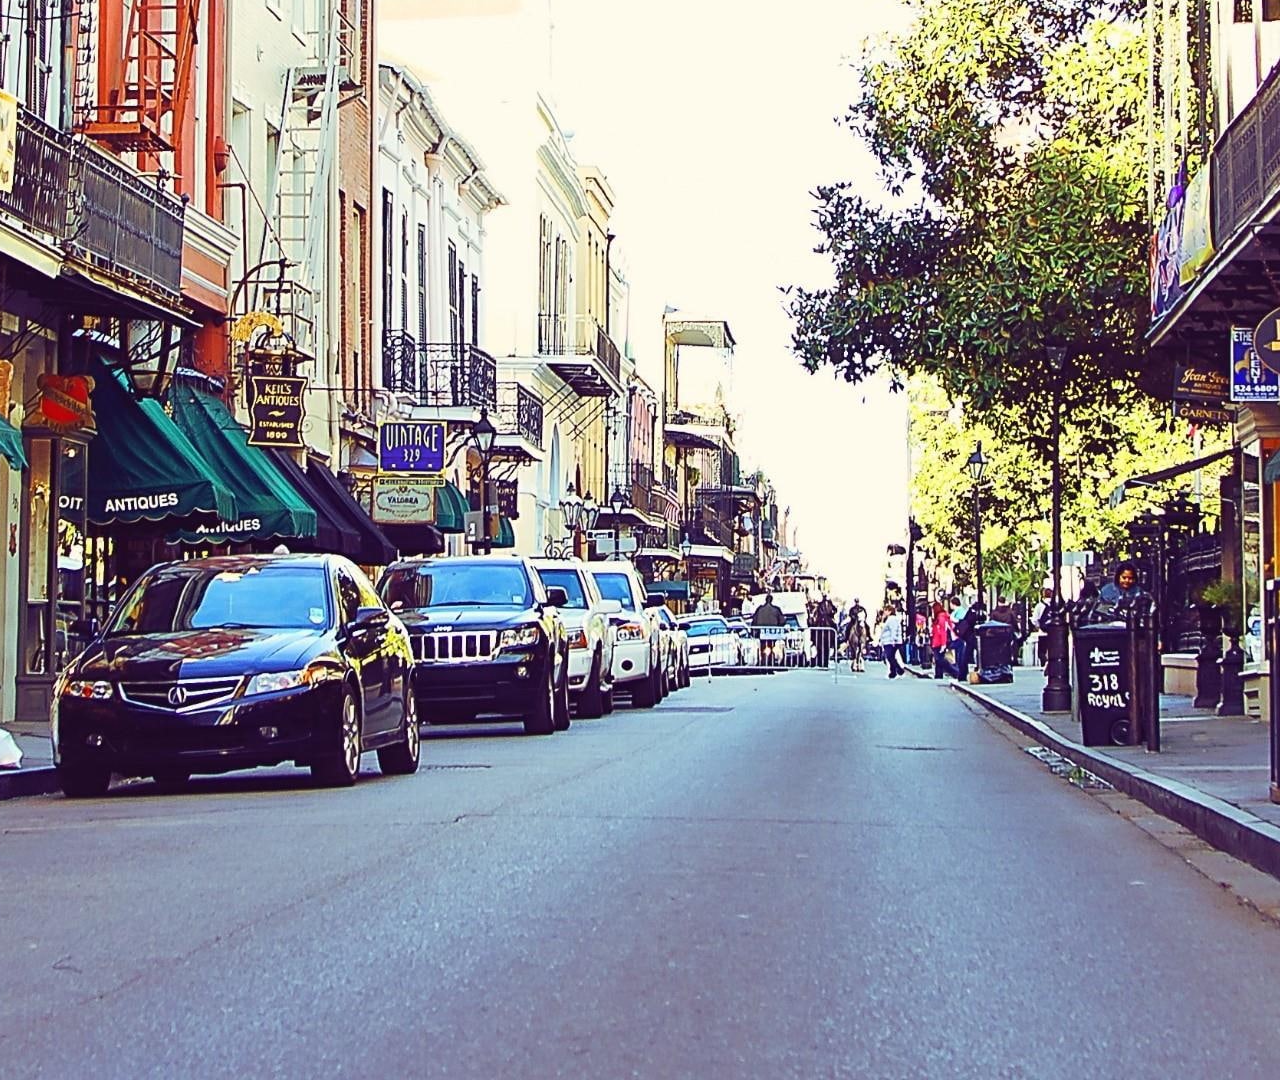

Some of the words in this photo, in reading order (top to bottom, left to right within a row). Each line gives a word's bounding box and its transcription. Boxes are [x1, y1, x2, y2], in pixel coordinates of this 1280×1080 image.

[265, 383, 292, 395] KEIL'S
[1234, 384, 1278, 393] 524-6809
[256, 394, 300, 407] ANTIQUES
[1180, 407, 1230, 421] GARNETS
[385, 424, 439, 452] VINTAGE
[403, 448, 421, 462] 329
[104, 492, 180, 513] ANTIQUES
[433, 625, 453, 633] Jeep
[1088, 673, 1119, 692] 318
